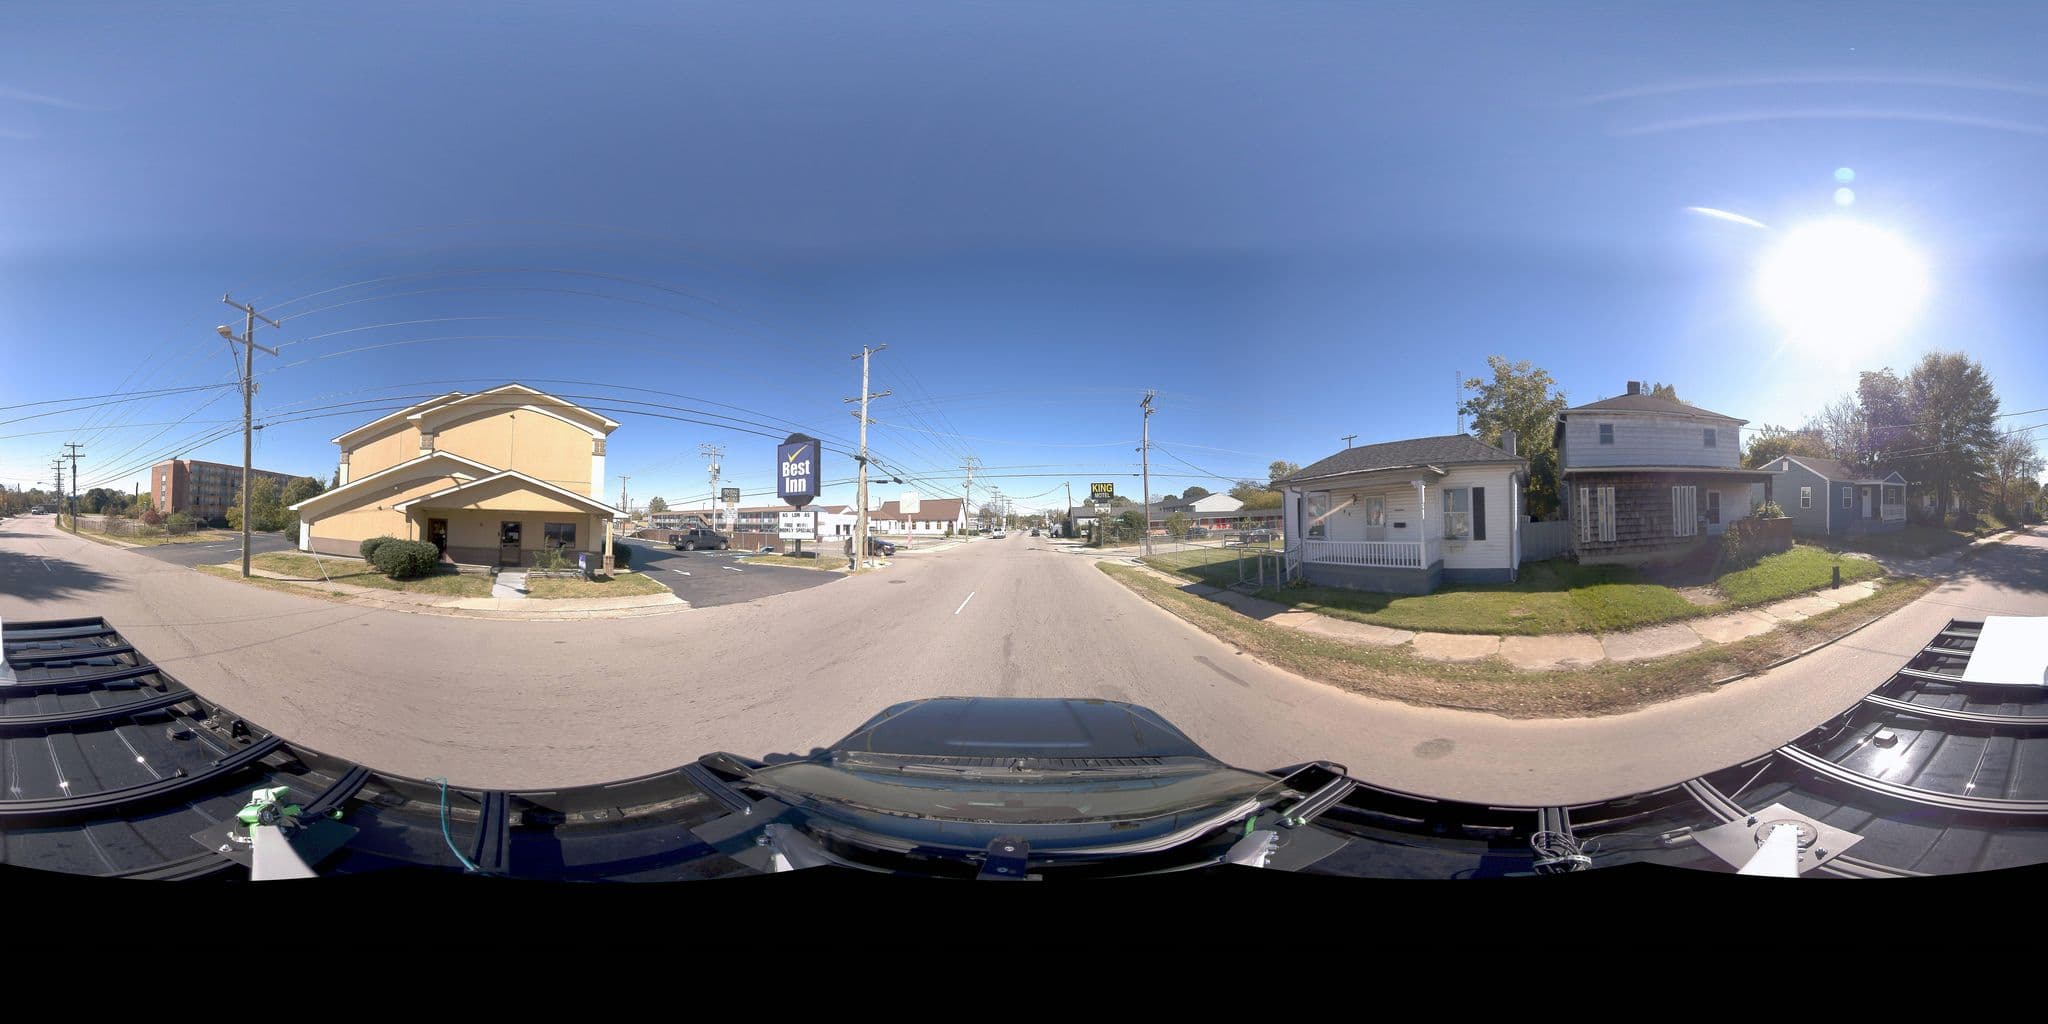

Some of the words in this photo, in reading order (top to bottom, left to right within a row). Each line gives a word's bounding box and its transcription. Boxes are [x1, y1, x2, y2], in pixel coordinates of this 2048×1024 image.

[782, 460, 810, 477] Best
[785, 477, 806, 493] Inn
[1092, 484, 1112, 492] KING
